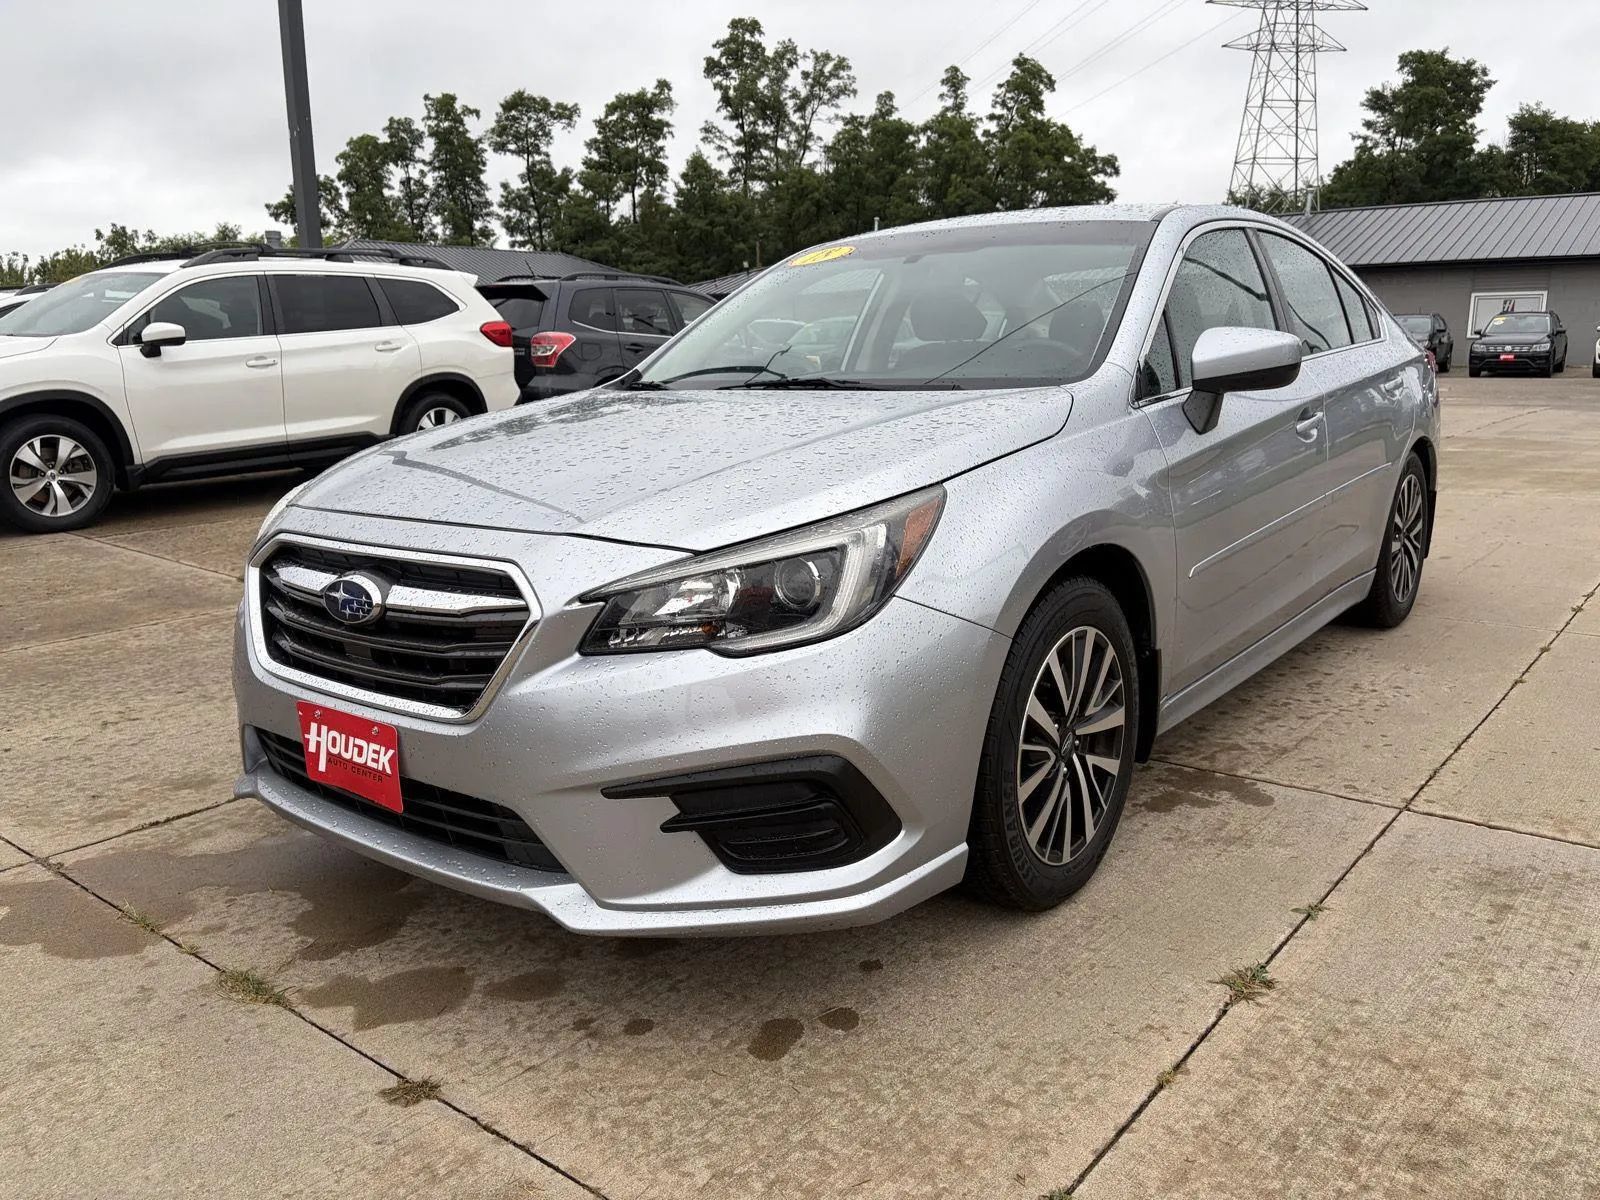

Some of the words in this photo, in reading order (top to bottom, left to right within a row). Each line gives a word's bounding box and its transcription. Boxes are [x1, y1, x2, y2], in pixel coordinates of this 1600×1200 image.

[304, 721, 395, 775] HOUDEK
[327, 757, 348, 770] AUTO
[351, 765, 383, 783] CENTER
